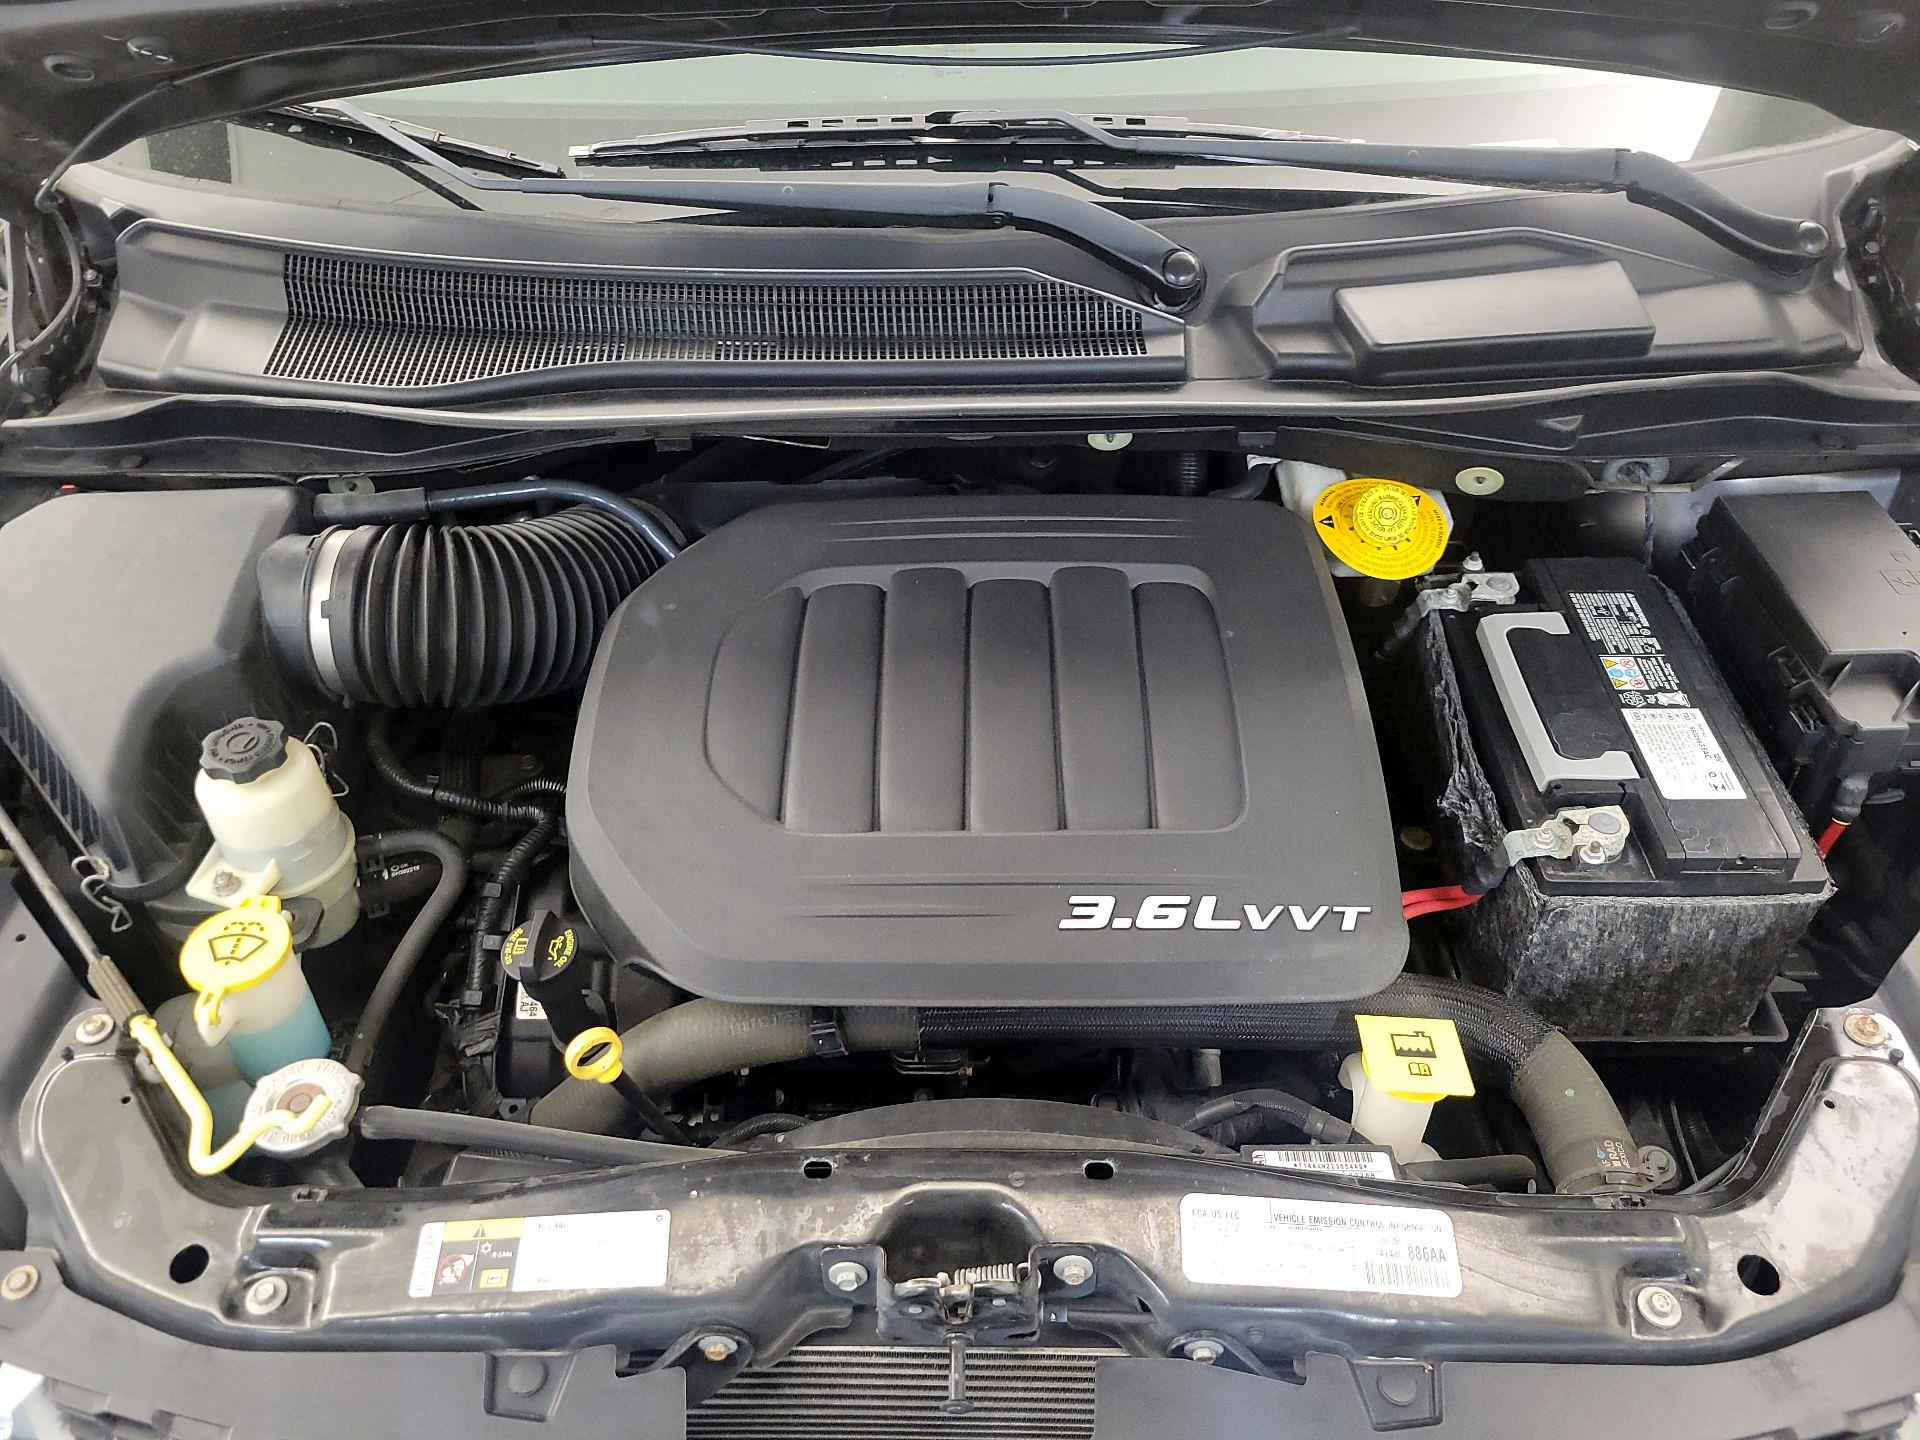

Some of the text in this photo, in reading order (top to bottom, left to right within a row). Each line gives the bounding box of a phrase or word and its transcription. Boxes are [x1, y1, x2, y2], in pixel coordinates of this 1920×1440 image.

[1057, 894, 1373, 932] 3.6L VVT
[512, 927, 524, 943] SAE
[553, 928, 575, 968] ENGINE OIL
[1604, 1140, 1620, 1161] RAD
[1211, 1209, 1222, 1219] US
[1273, 1213, 1306, 1224] VEHICLE
[1308, 1215, 1347, 1227] EMISSION
[1349, 1218, 1385, 1229] CONTROL
[1407, 1244, 1448, 1263] 886AA
